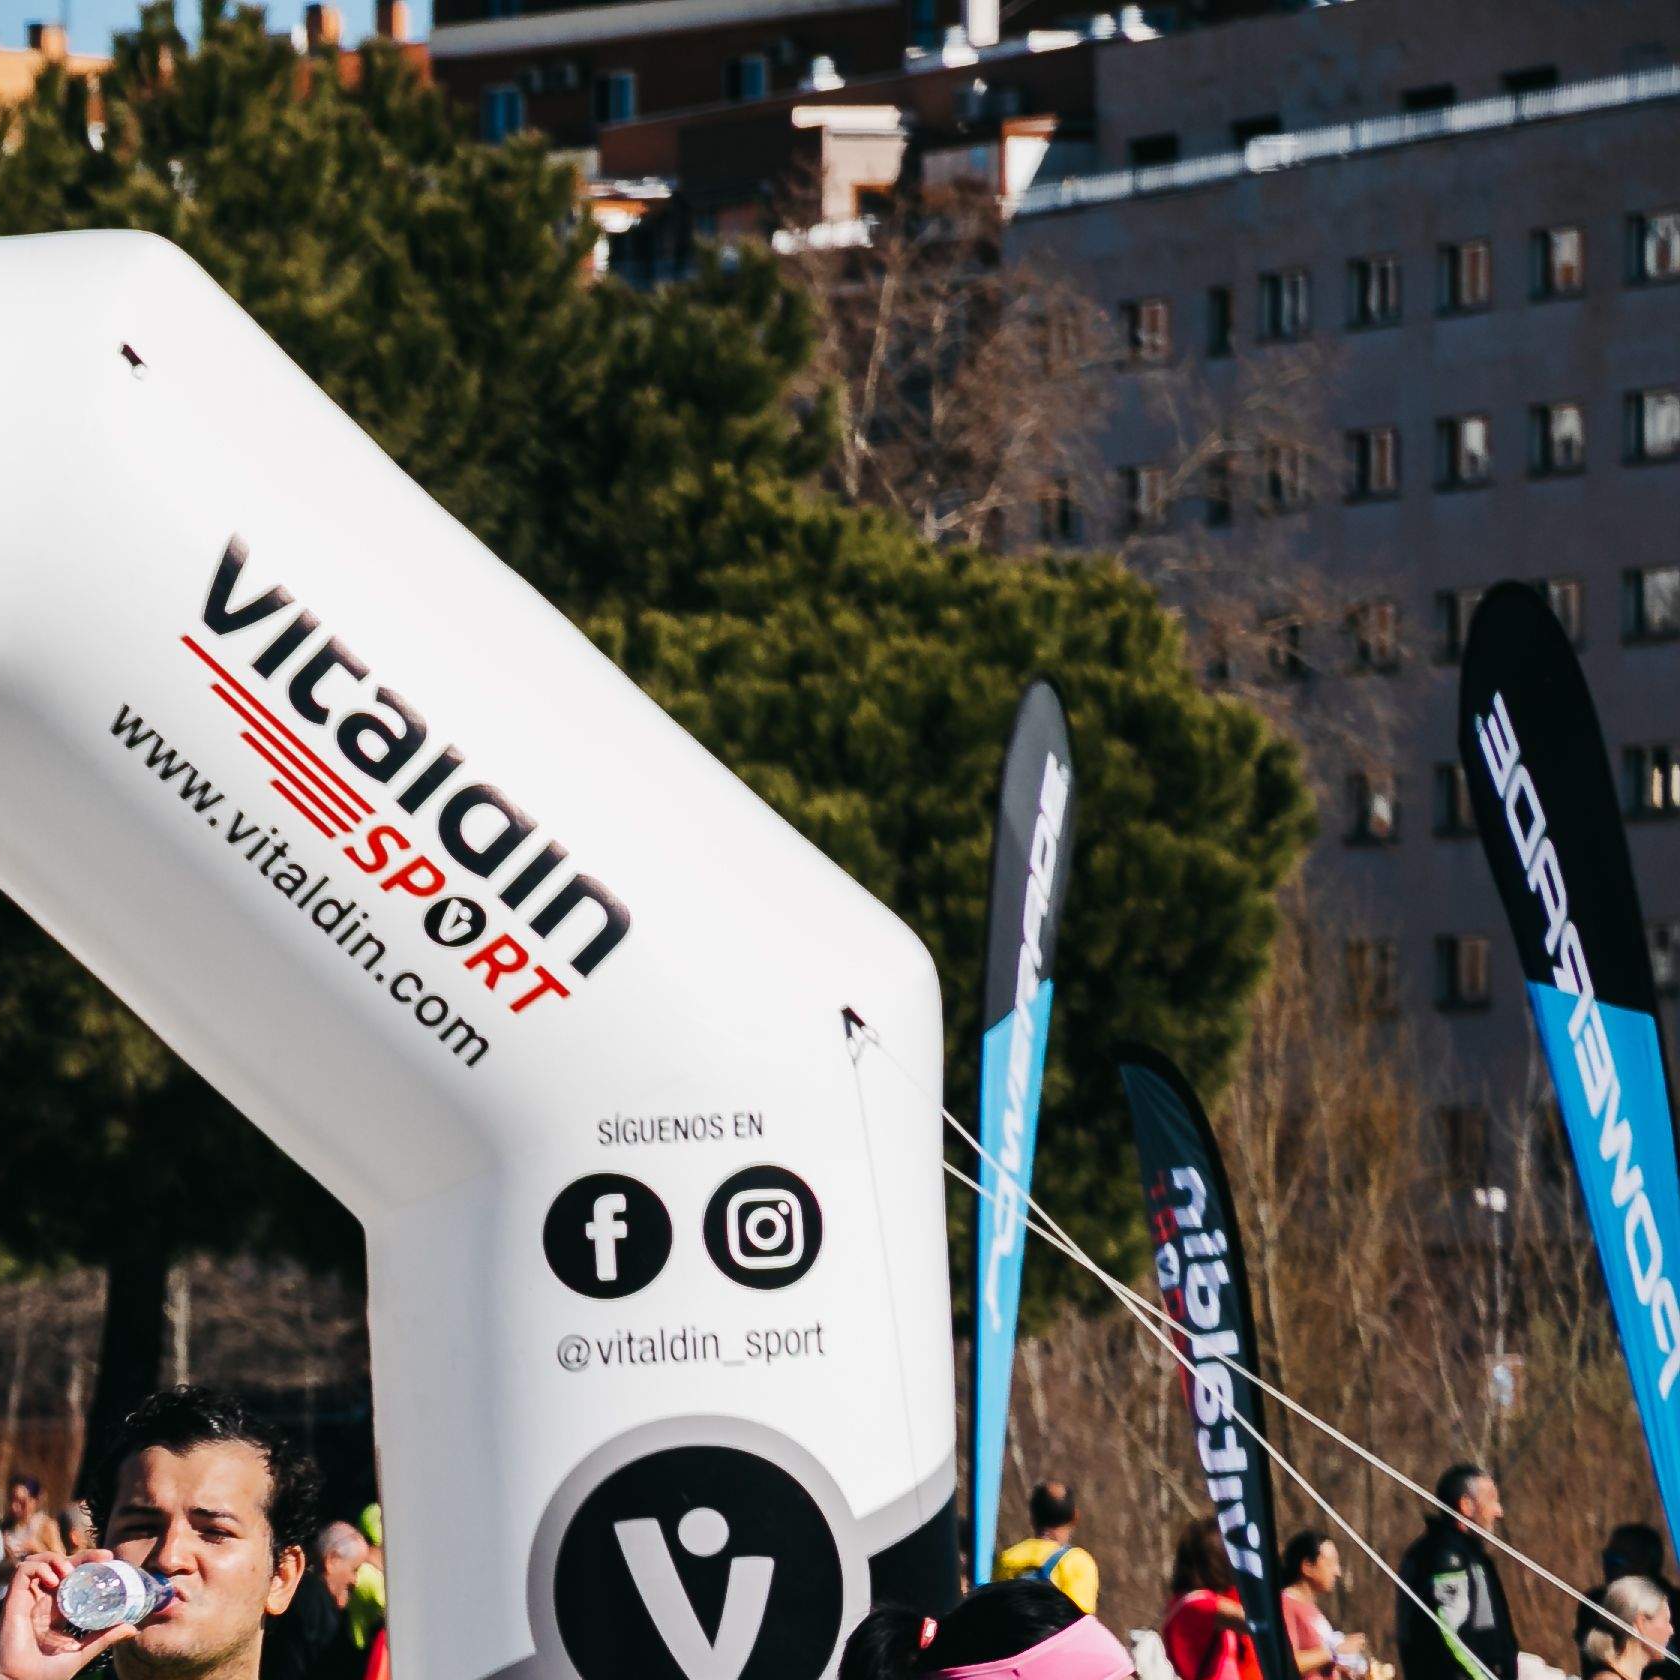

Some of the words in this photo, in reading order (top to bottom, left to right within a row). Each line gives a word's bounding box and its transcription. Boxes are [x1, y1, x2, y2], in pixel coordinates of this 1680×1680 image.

[110, 703, 490, 1070] www.vitaldin.com
[343, 823, 571, 1016] SPORT
[597, 1112, 724, 1147] SÍGUENOS
[733, 1111, 764, 1139] EN
[556, 1320, 826, 1373] @vitaldin_sport
